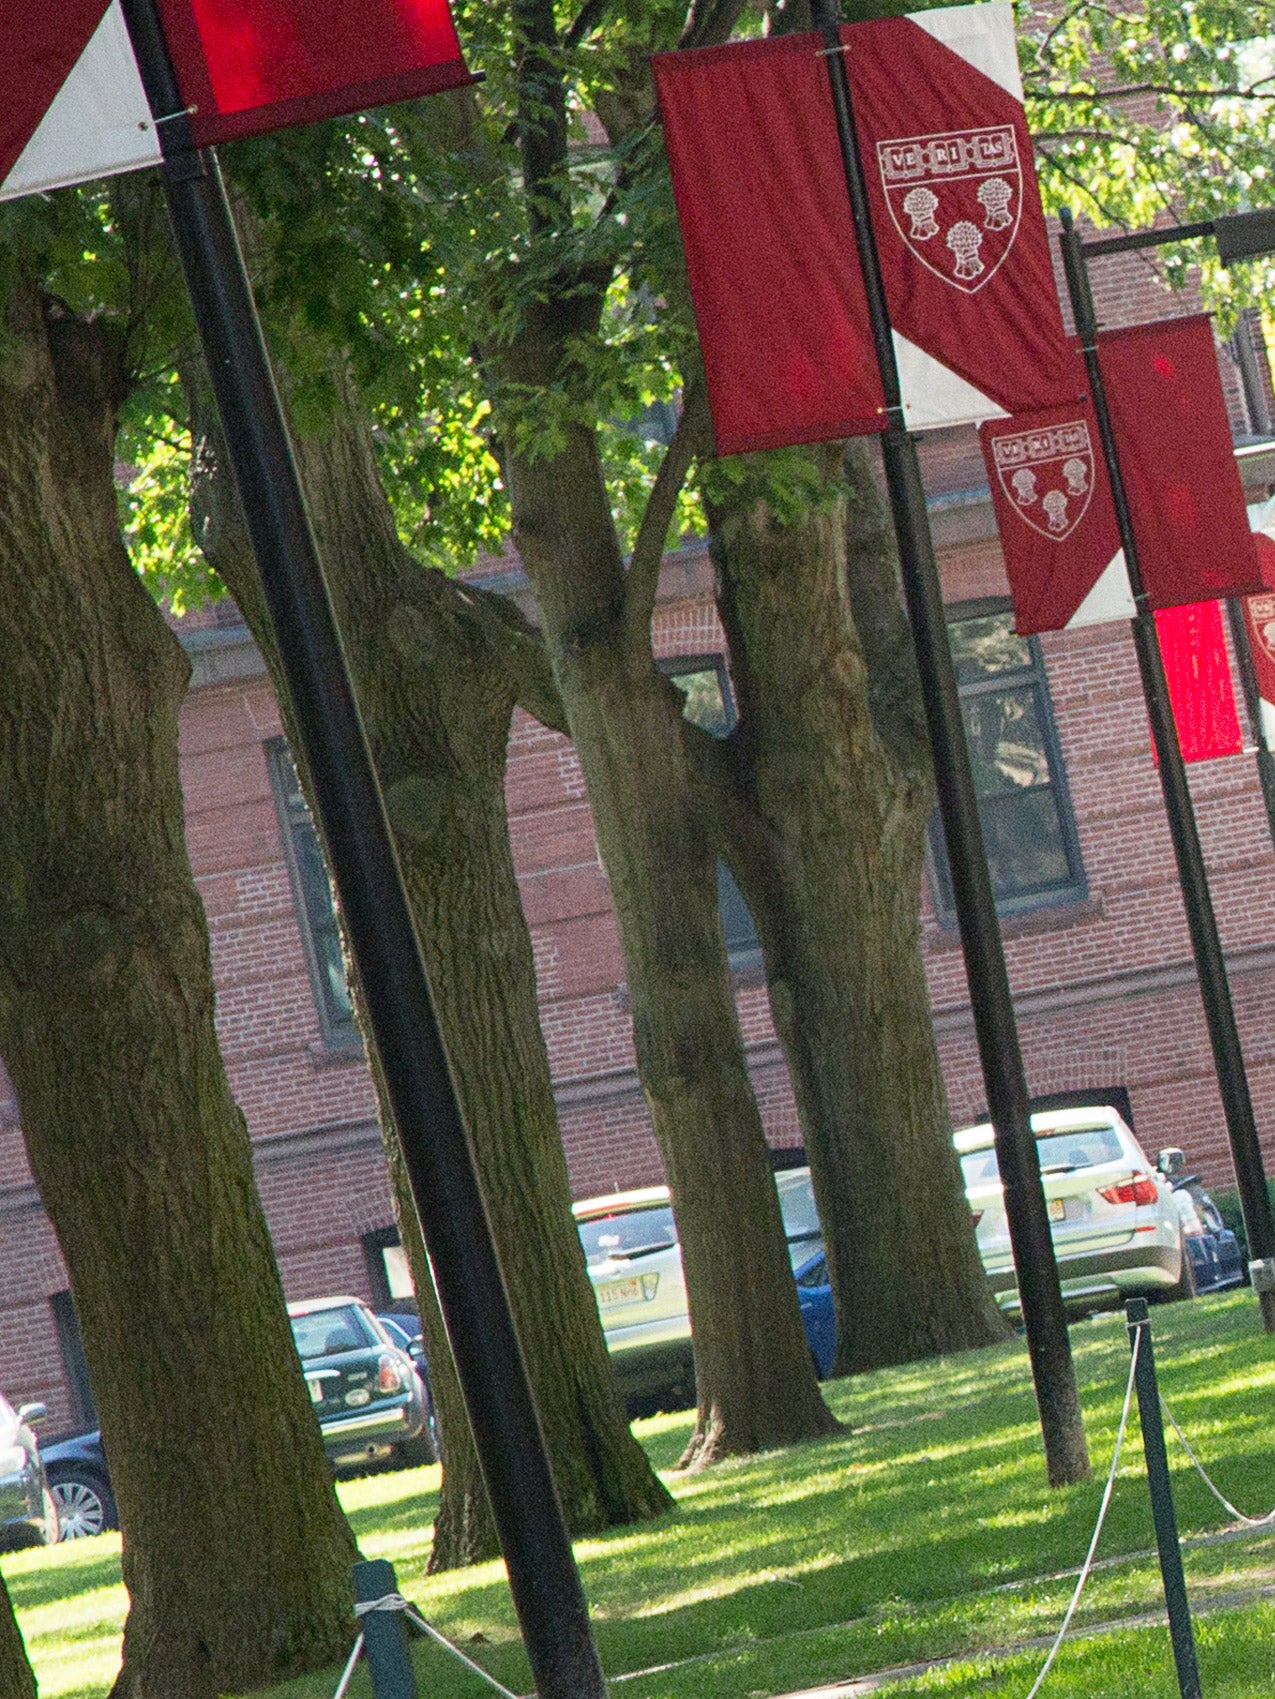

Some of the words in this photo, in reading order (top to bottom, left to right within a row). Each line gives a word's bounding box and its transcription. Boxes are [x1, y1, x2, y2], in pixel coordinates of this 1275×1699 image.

[892, 152, 916, 166] VE
[936, 147, 958, 161] RI
[980, 141, 1003, 155] TAS
